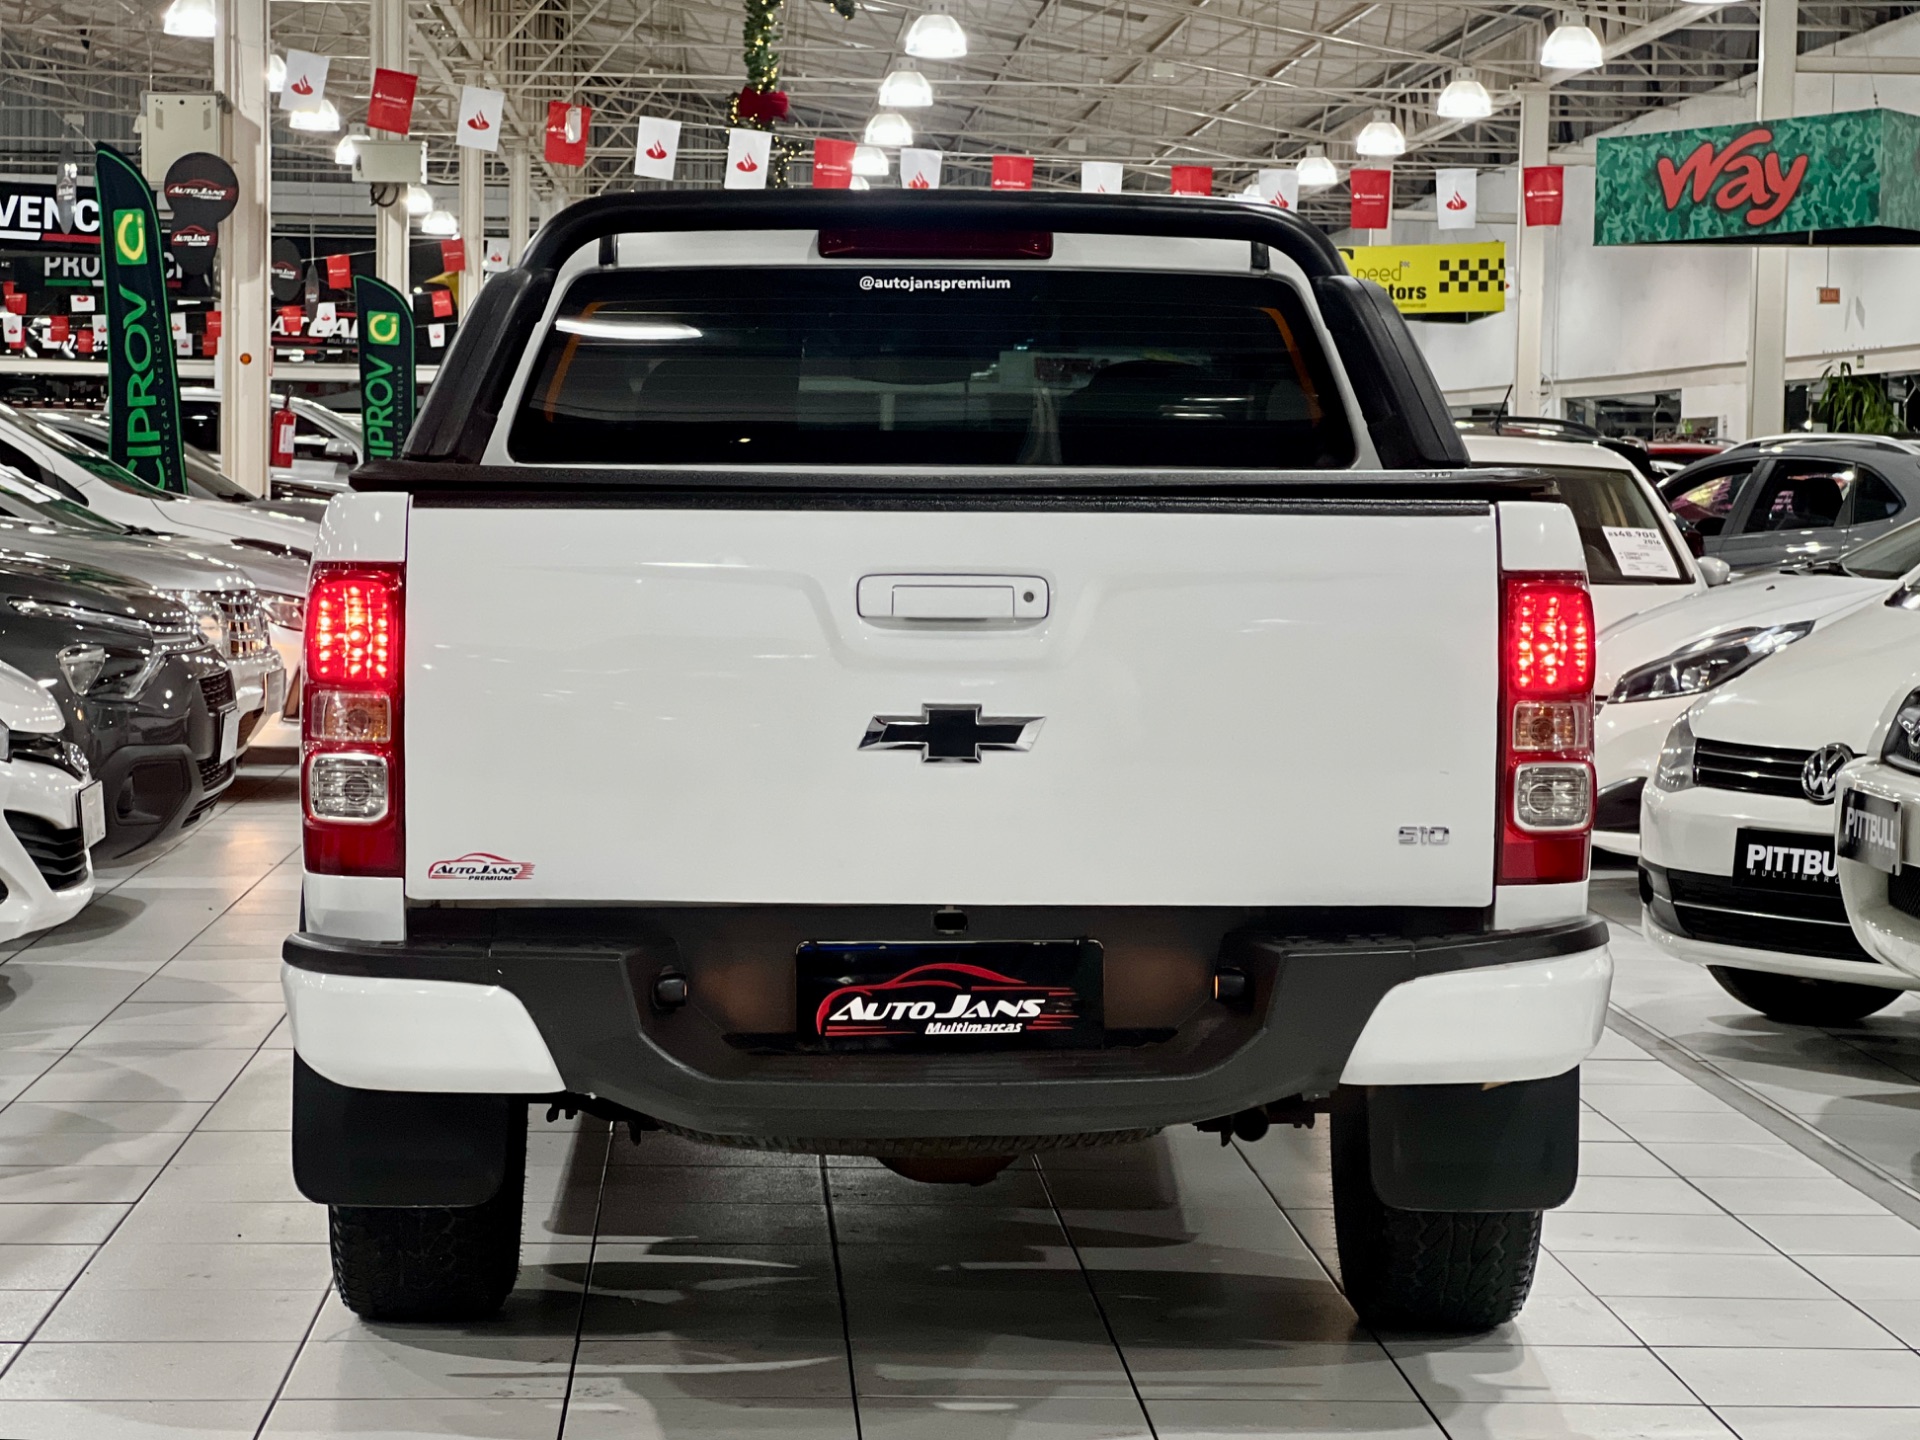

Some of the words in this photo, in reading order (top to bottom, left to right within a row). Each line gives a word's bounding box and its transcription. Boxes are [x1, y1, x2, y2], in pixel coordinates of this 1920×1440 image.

[1657, 129, 1808, 226] Way
[859, 276, 1011, 292] @autojanspremium
[1382, 283, 1427, 300] tors
[365, 353, 394, 460] IPROV
[1398, 826, 1450, 845] S10
[1845, 806, 1897, 850] PITTBULL
[1746, 844, 1838, 877] PITTBU
[1750, 868, 1840, 885] MULTIMARC
[828, 996, 936, 1021] AUTO
[941, 994, 1046, 1020] JANS
[924, 1022, 1022, 1035] Multimarcas
